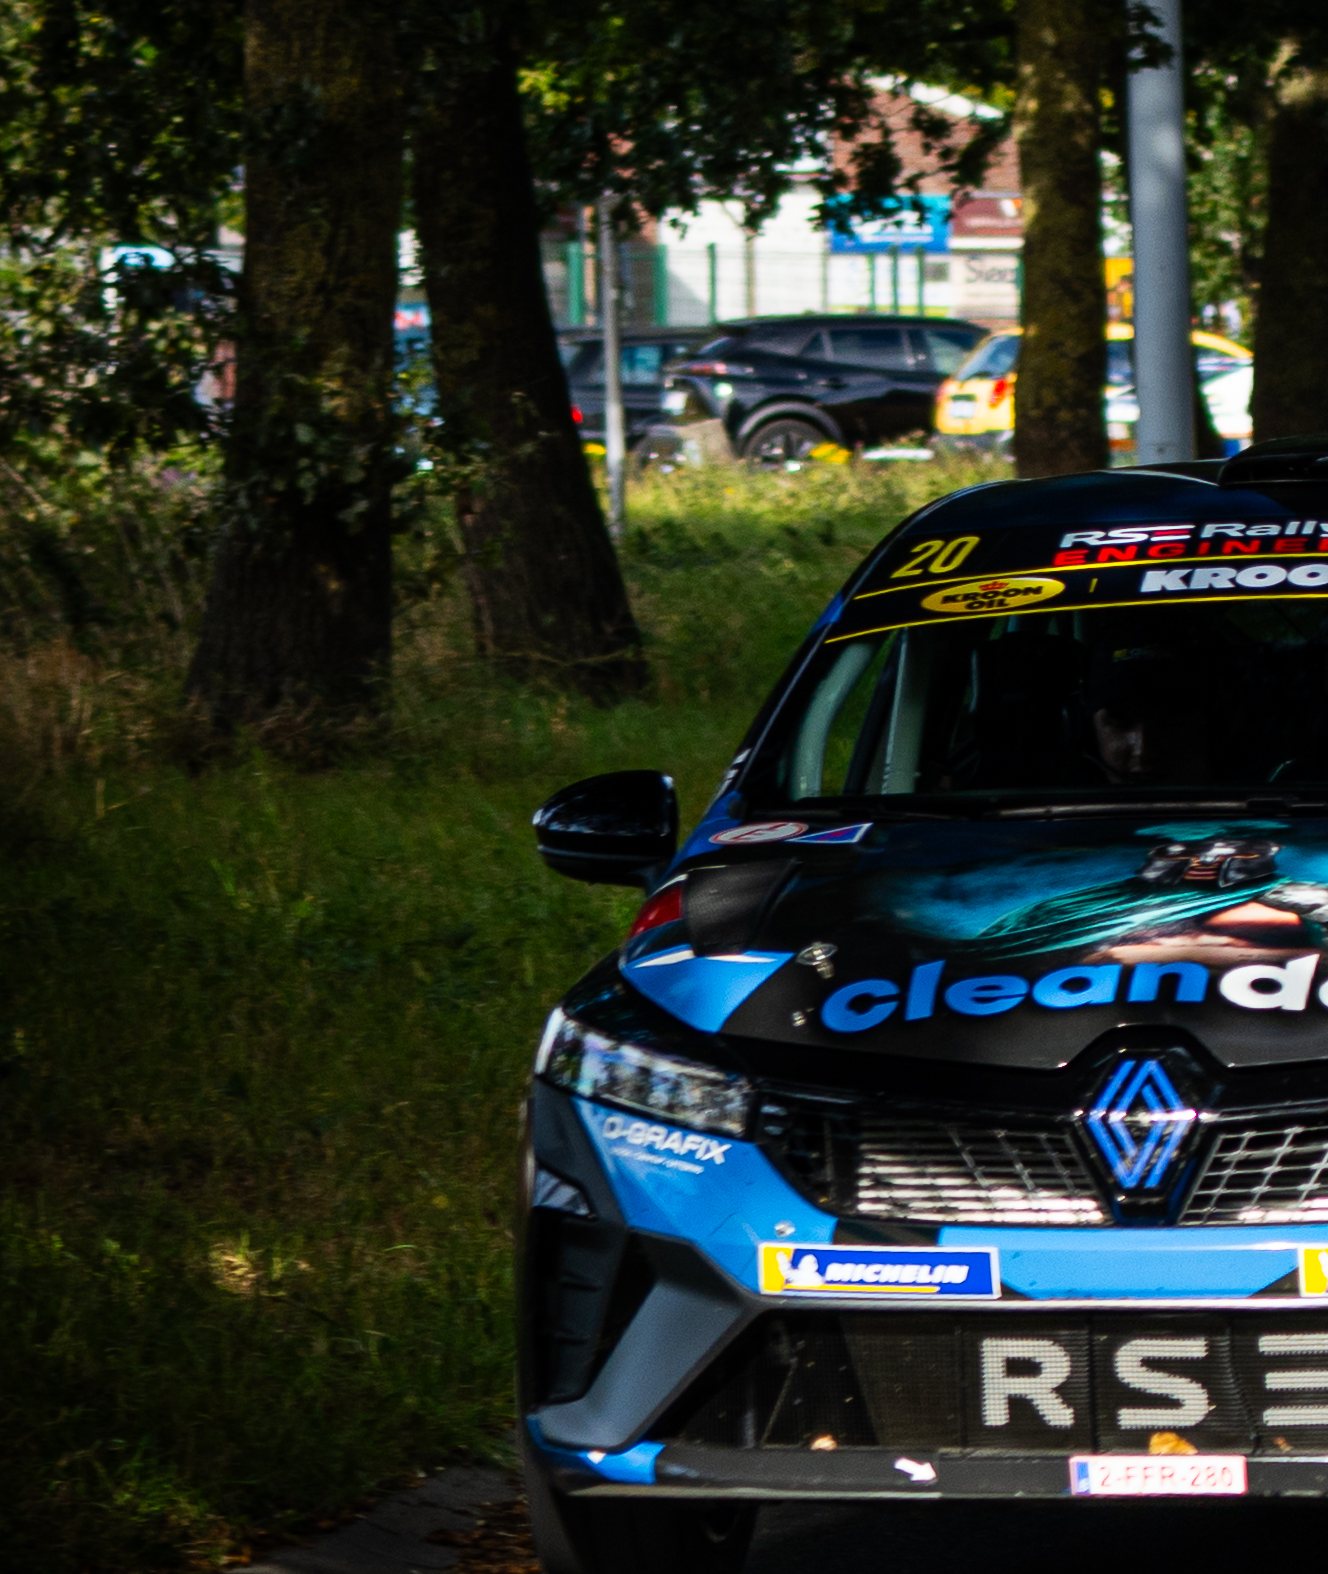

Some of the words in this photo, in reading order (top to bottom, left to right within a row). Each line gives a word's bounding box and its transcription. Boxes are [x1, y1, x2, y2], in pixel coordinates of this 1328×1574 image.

[1060, 524, 1196, 548] RSE
[890, 536, 980, 578] 20
[941, 585, 1043, 604] KROON
[965, 598, 1009, 610] OIL
[824, 1262, 970, 1284] MICHELIN
[1099, 1465, 1234, 1488] 2-FFR-280
